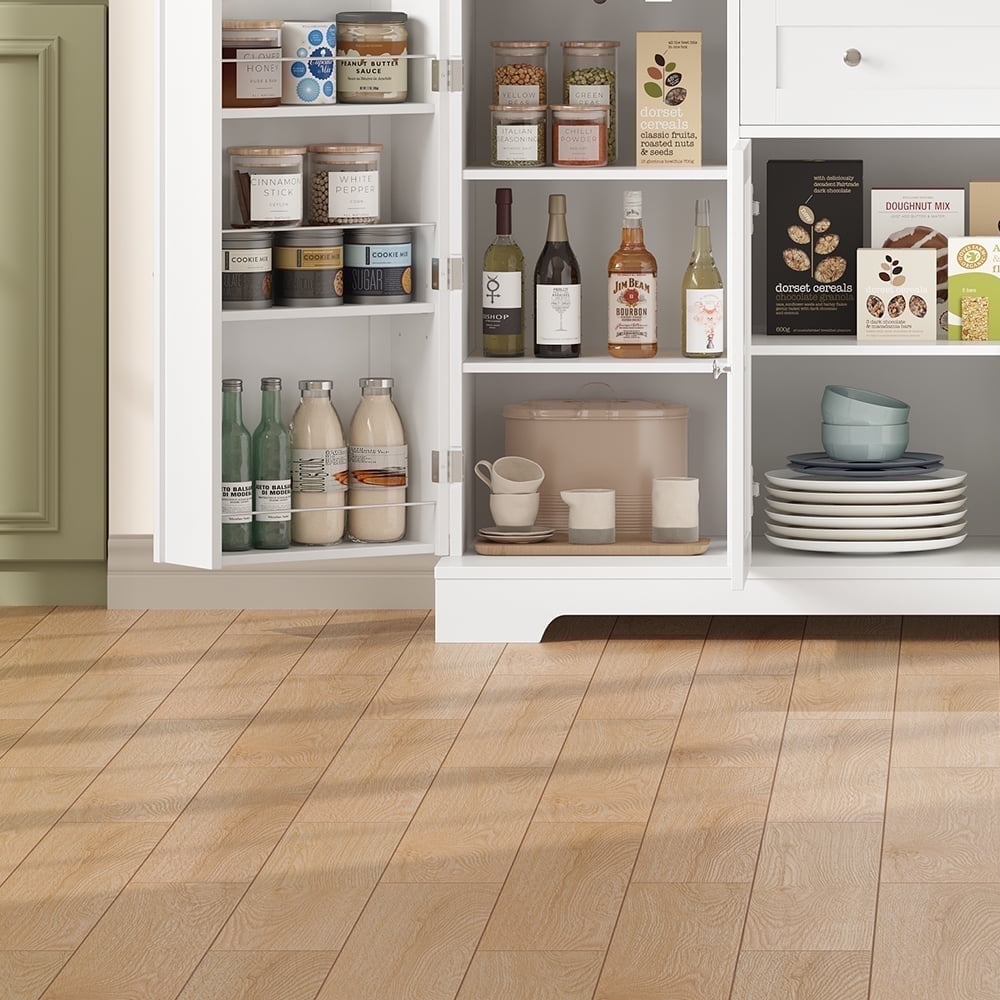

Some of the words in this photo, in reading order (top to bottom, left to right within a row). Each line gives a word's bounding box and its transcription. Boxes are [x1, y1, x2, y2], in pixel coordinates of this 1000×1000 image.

[247, 64, 279, 73] HONEY
[640, 106, 684, 118] dorset
[640, 118, 688, 130] cereals
[650, 148, 674, 156] seeds
[339, 175, 374, 184] WHITE
[264, 189, 293, 197] STICK
[336, 186, 375, 194] PEPPER
[886, 202, 932, 210] DOUGHNUT
[935, 202, 950, 210] MIX
[352, 269, 383, 290] SUGAR
[775, 283, 811, 292] dorset
[813, 283, 853, 292] cereals
[820, 294, 854, 302] granola
[616, 308, 648, 316] BOURBON
